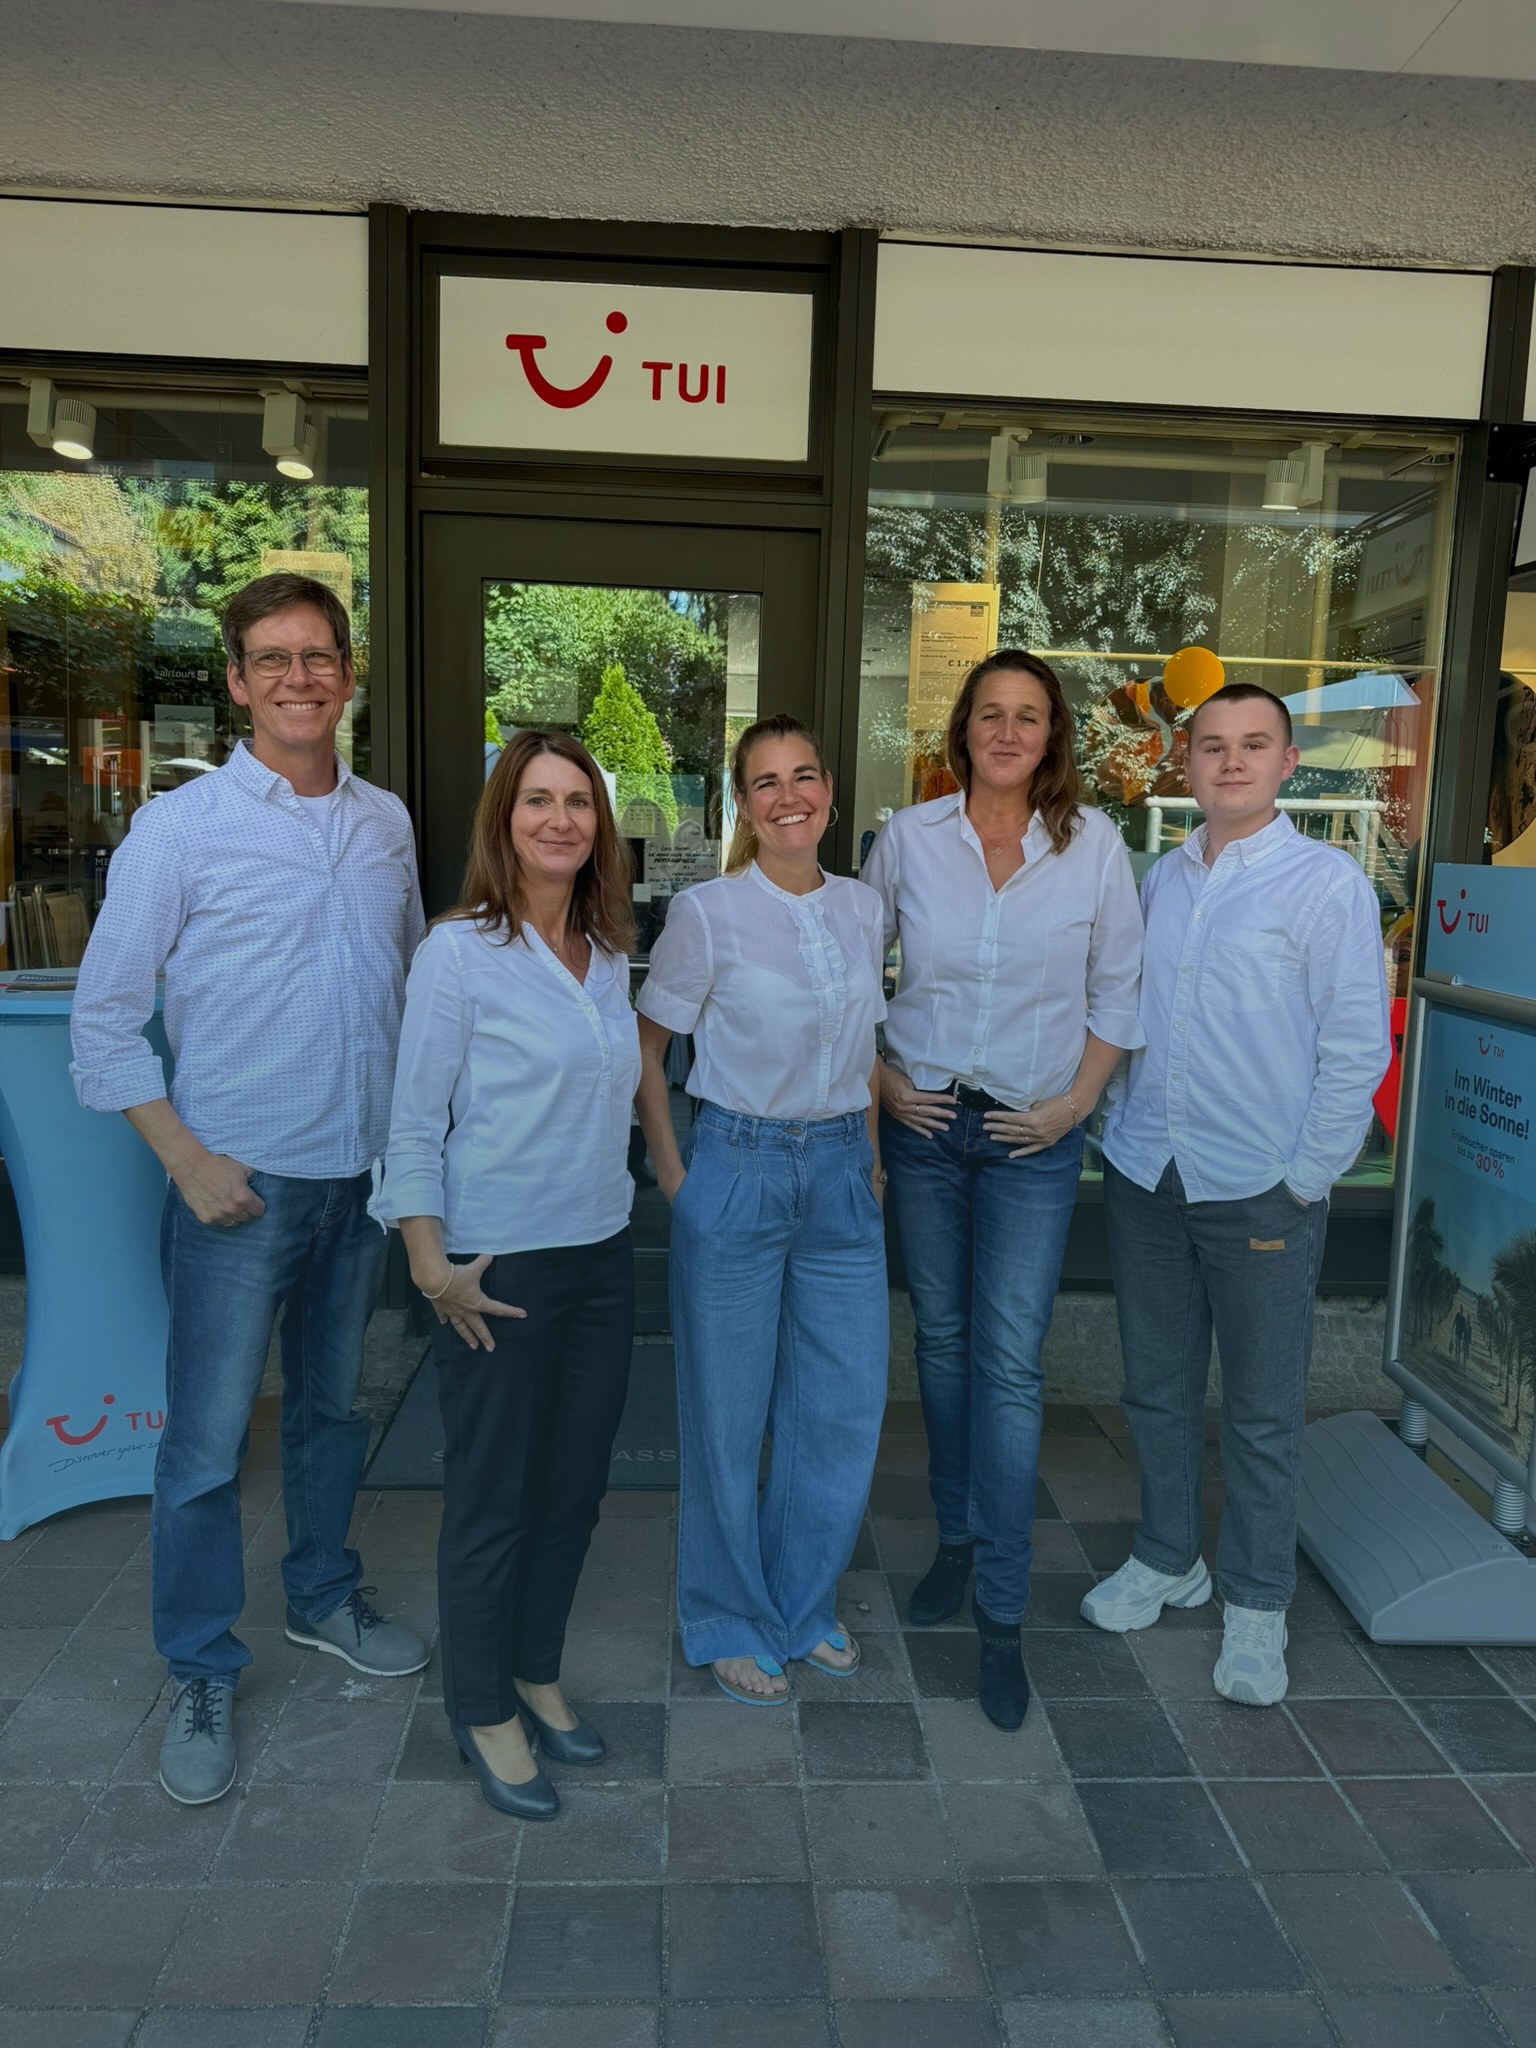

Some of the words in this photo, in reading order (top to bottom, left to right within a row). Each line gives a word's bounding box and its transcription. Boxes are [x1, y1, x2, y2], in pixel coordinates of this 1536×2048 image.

[642, 361, 726, 404] TUI
[160, 668, 196, 679] airtours
[1467, 911, 1489, 934] TUI
[1492, 1045, 1505, 1059] TUI
[1453, 1068, 1470, 1093] Im
[1473, 1074, 1523, 1110] Winter
[1444, 1090, 1455, 1112] in
[1457, 1095, 1477, 1120] die
[1479, 1103, 1530, 1140] Sonne!
[1457, 1143, 1467, 1158] bis
[1467, 1151, 1475, 1161] zu
[1475, 1152, 1505, 1180] 30%
[1489, 1146, 1516, 1166] sparen
[125, 1410, 164, 1431] TU
[48, 1448, 116, 1473] Discover
[118, 1443, 146, 1461] your
